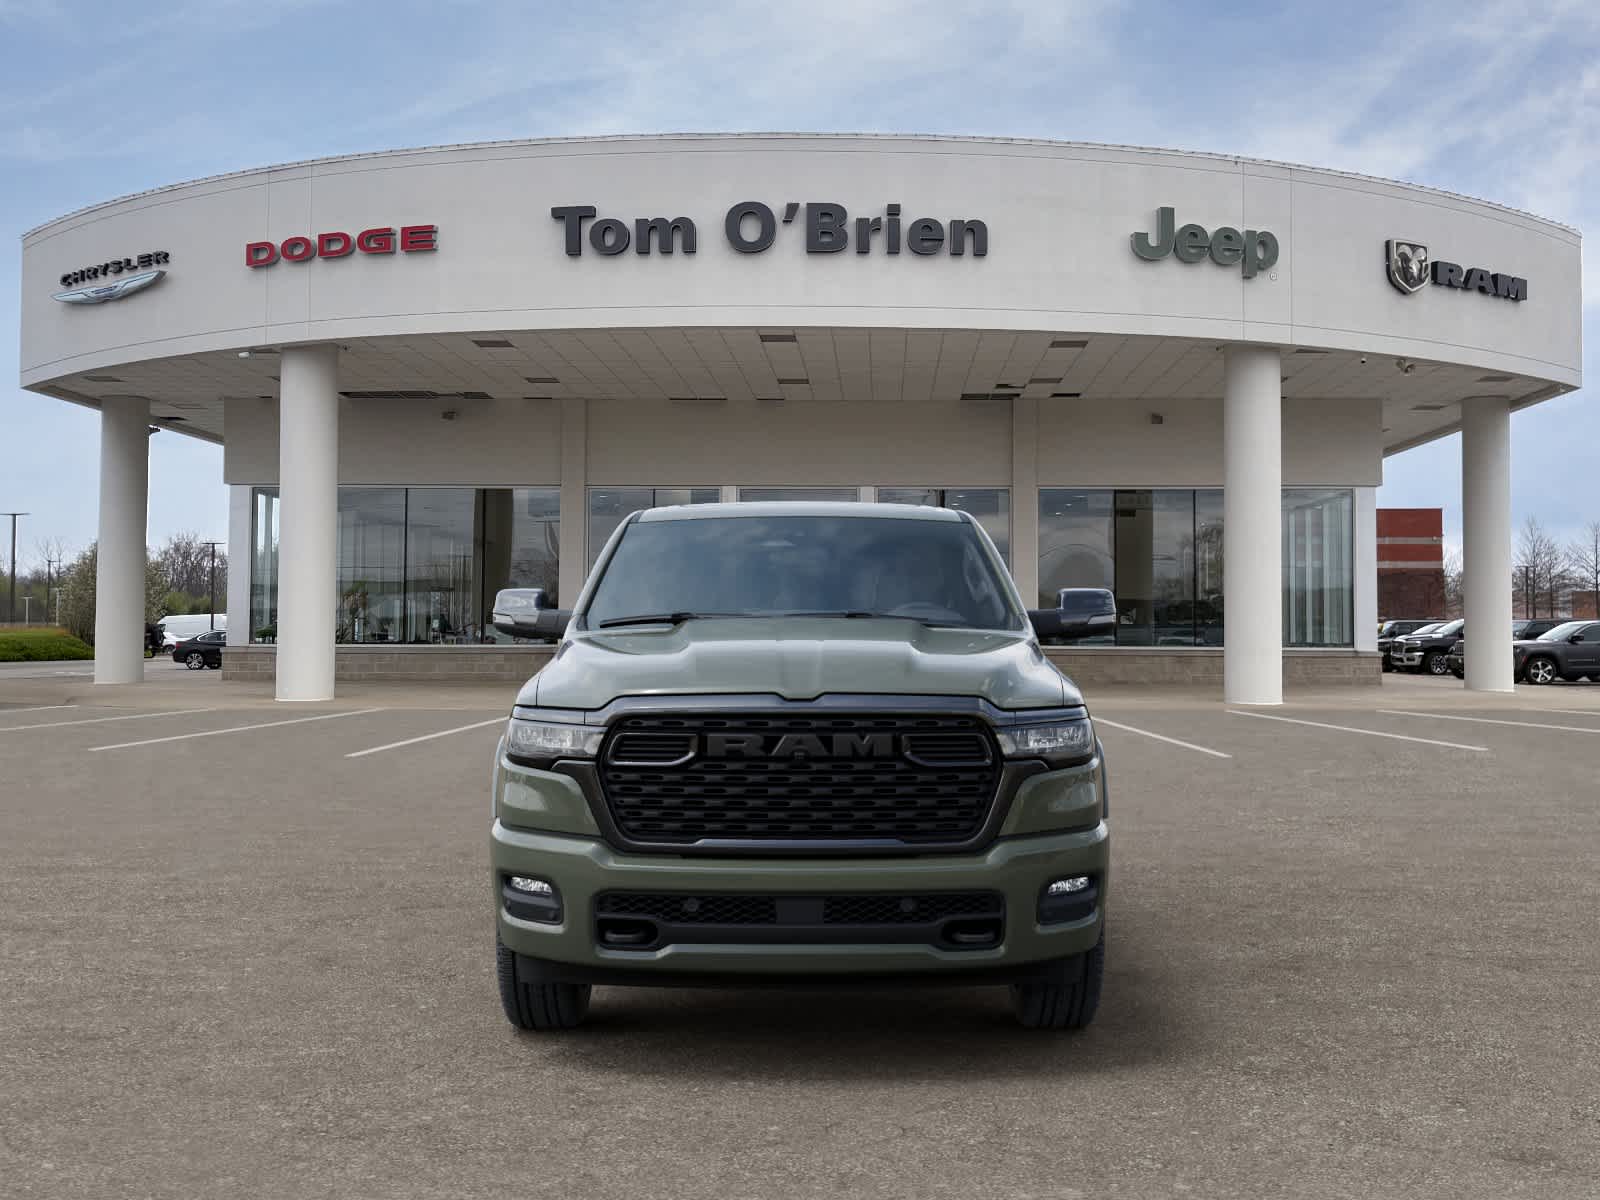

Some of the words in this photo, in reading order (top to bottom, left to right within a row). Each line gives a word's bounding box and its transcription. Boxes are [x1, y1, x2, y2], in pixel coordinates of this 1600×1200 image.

[245, 225, 438, 268] DODGE
[551, 205, 697, 256] Tom
[725, 201, 988, 256] O'Brien
[1131, 207, 1279, 278] Jeep
[60, 251, 169, 286] CHRYSLER
[1431, 260, 1527, 301] RAM
[706, 733, 894, 757] RAM
